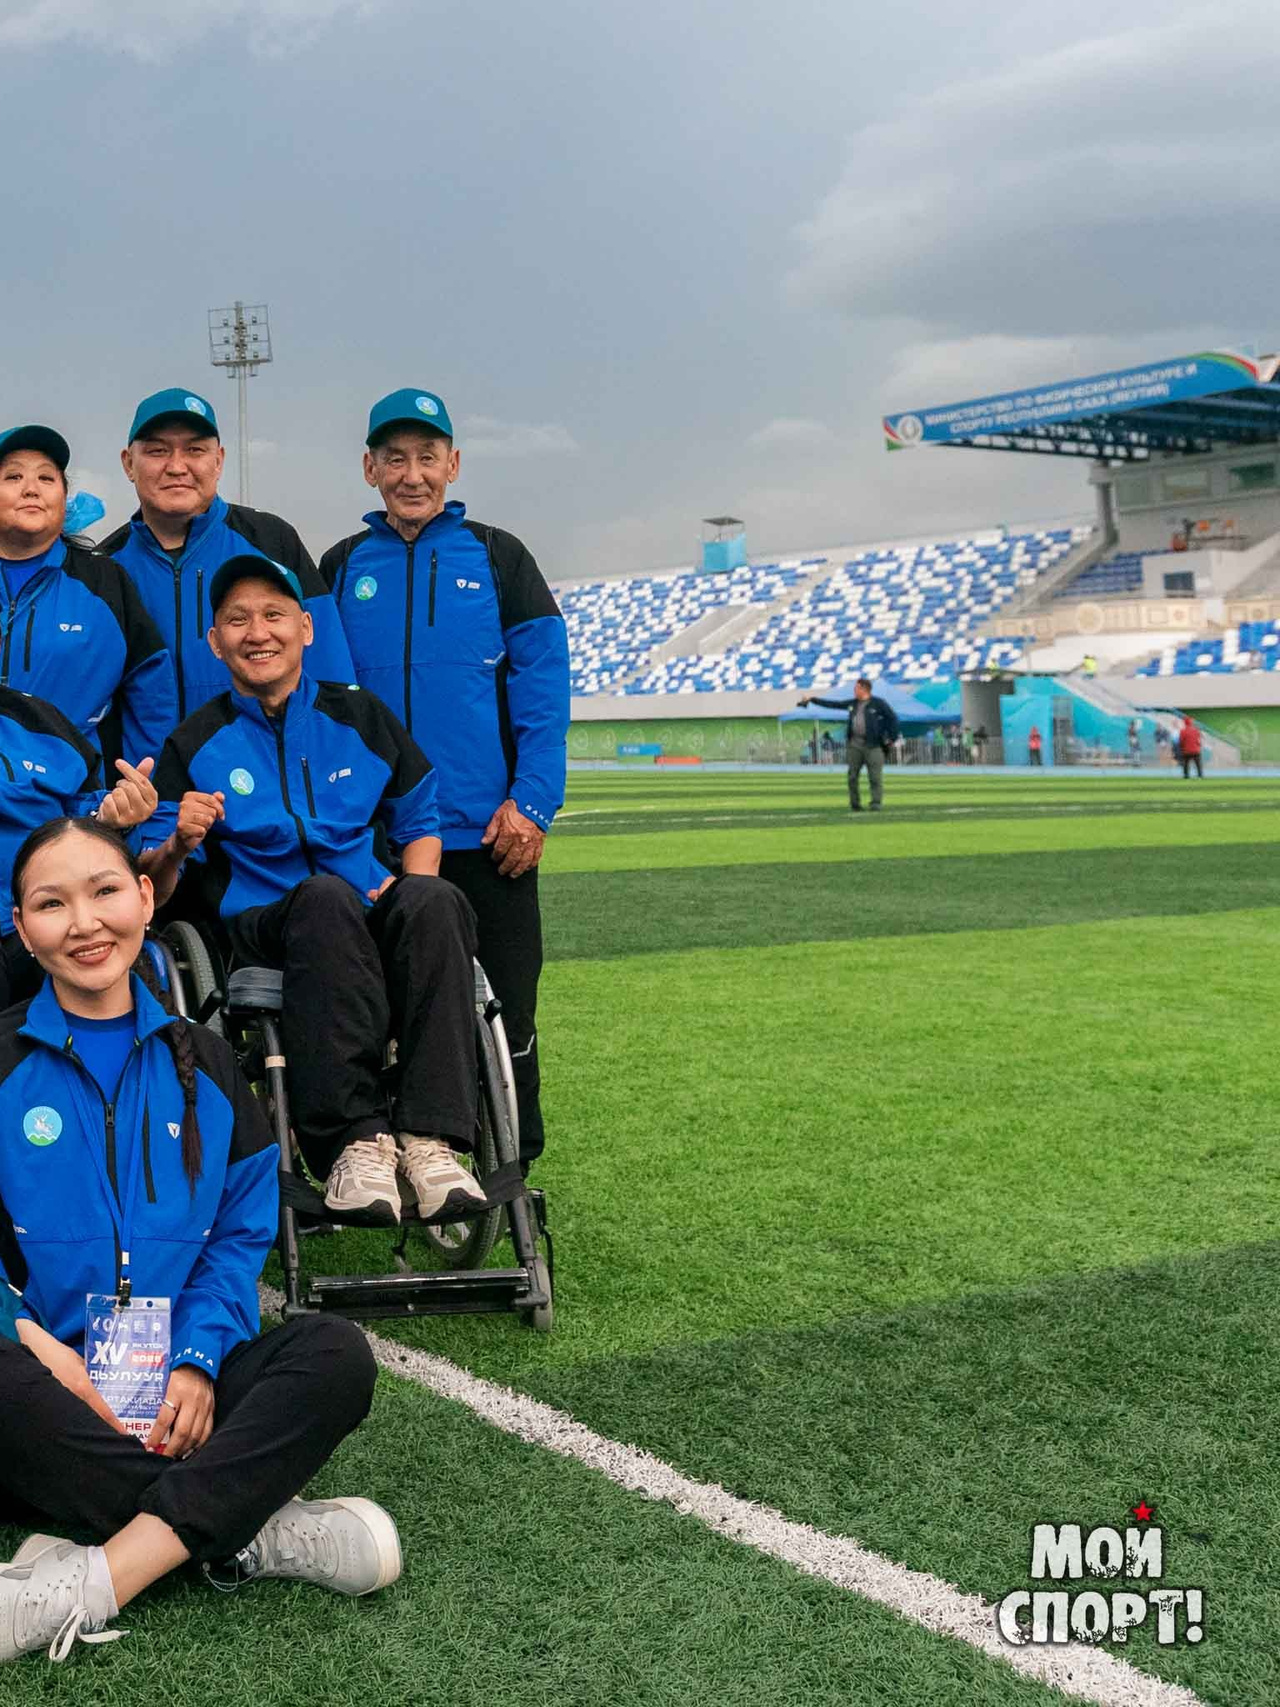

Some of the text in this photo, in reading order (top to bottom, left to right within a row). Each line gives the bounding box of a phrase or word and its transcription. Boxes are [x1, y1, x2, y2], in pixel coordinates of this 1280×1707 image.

[924, 399, 1013, 425] МИНИСТЕРСТВО
[1034, 379, 1118, 405] ФИЗИЧЕСКОЙ
[1119, 364, 1184, 388] КУЛЬТУРЕ
[949, 416, 994, 434] СПОРТУ
[995, 401, 1073, 425] РЕСПУБЛИКИ
[90, 1341, 128, 1365] XV
[89, 1370, 164, 1382] ДЬУЛУУР
[124, 1422, 152, 1431] НЕР
